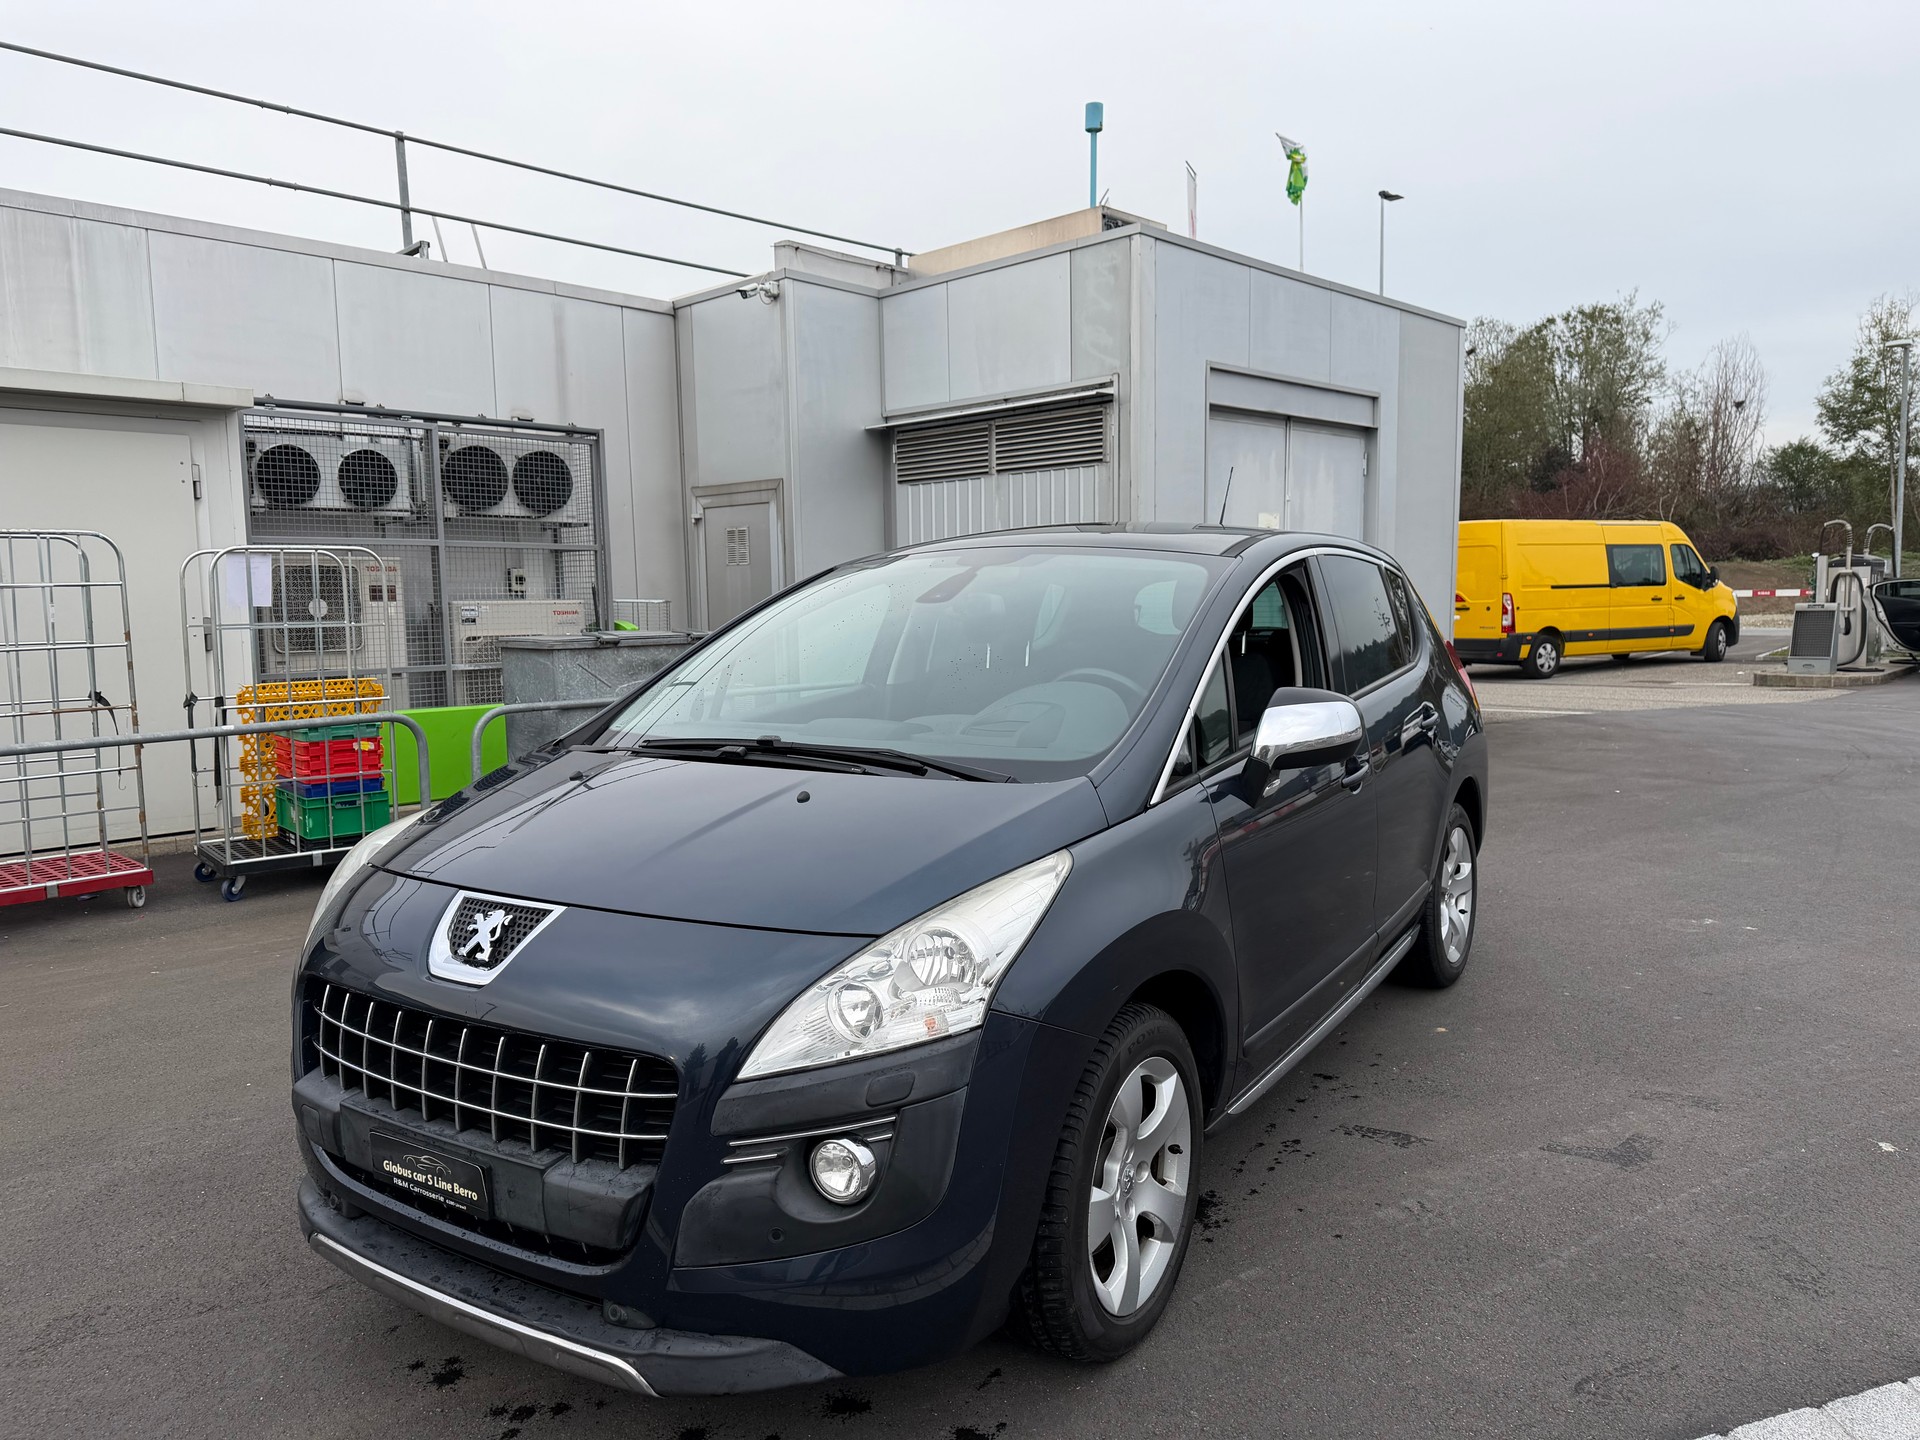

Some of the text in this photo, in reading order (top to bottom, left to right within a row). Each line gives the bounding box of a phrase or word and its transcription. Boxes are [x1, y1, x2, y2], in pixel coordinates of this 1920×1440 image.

[383, 1160, 478, 1201] Globus car S Line Berro
[393, 1177, 445, 1202] R&M Carrosserie
